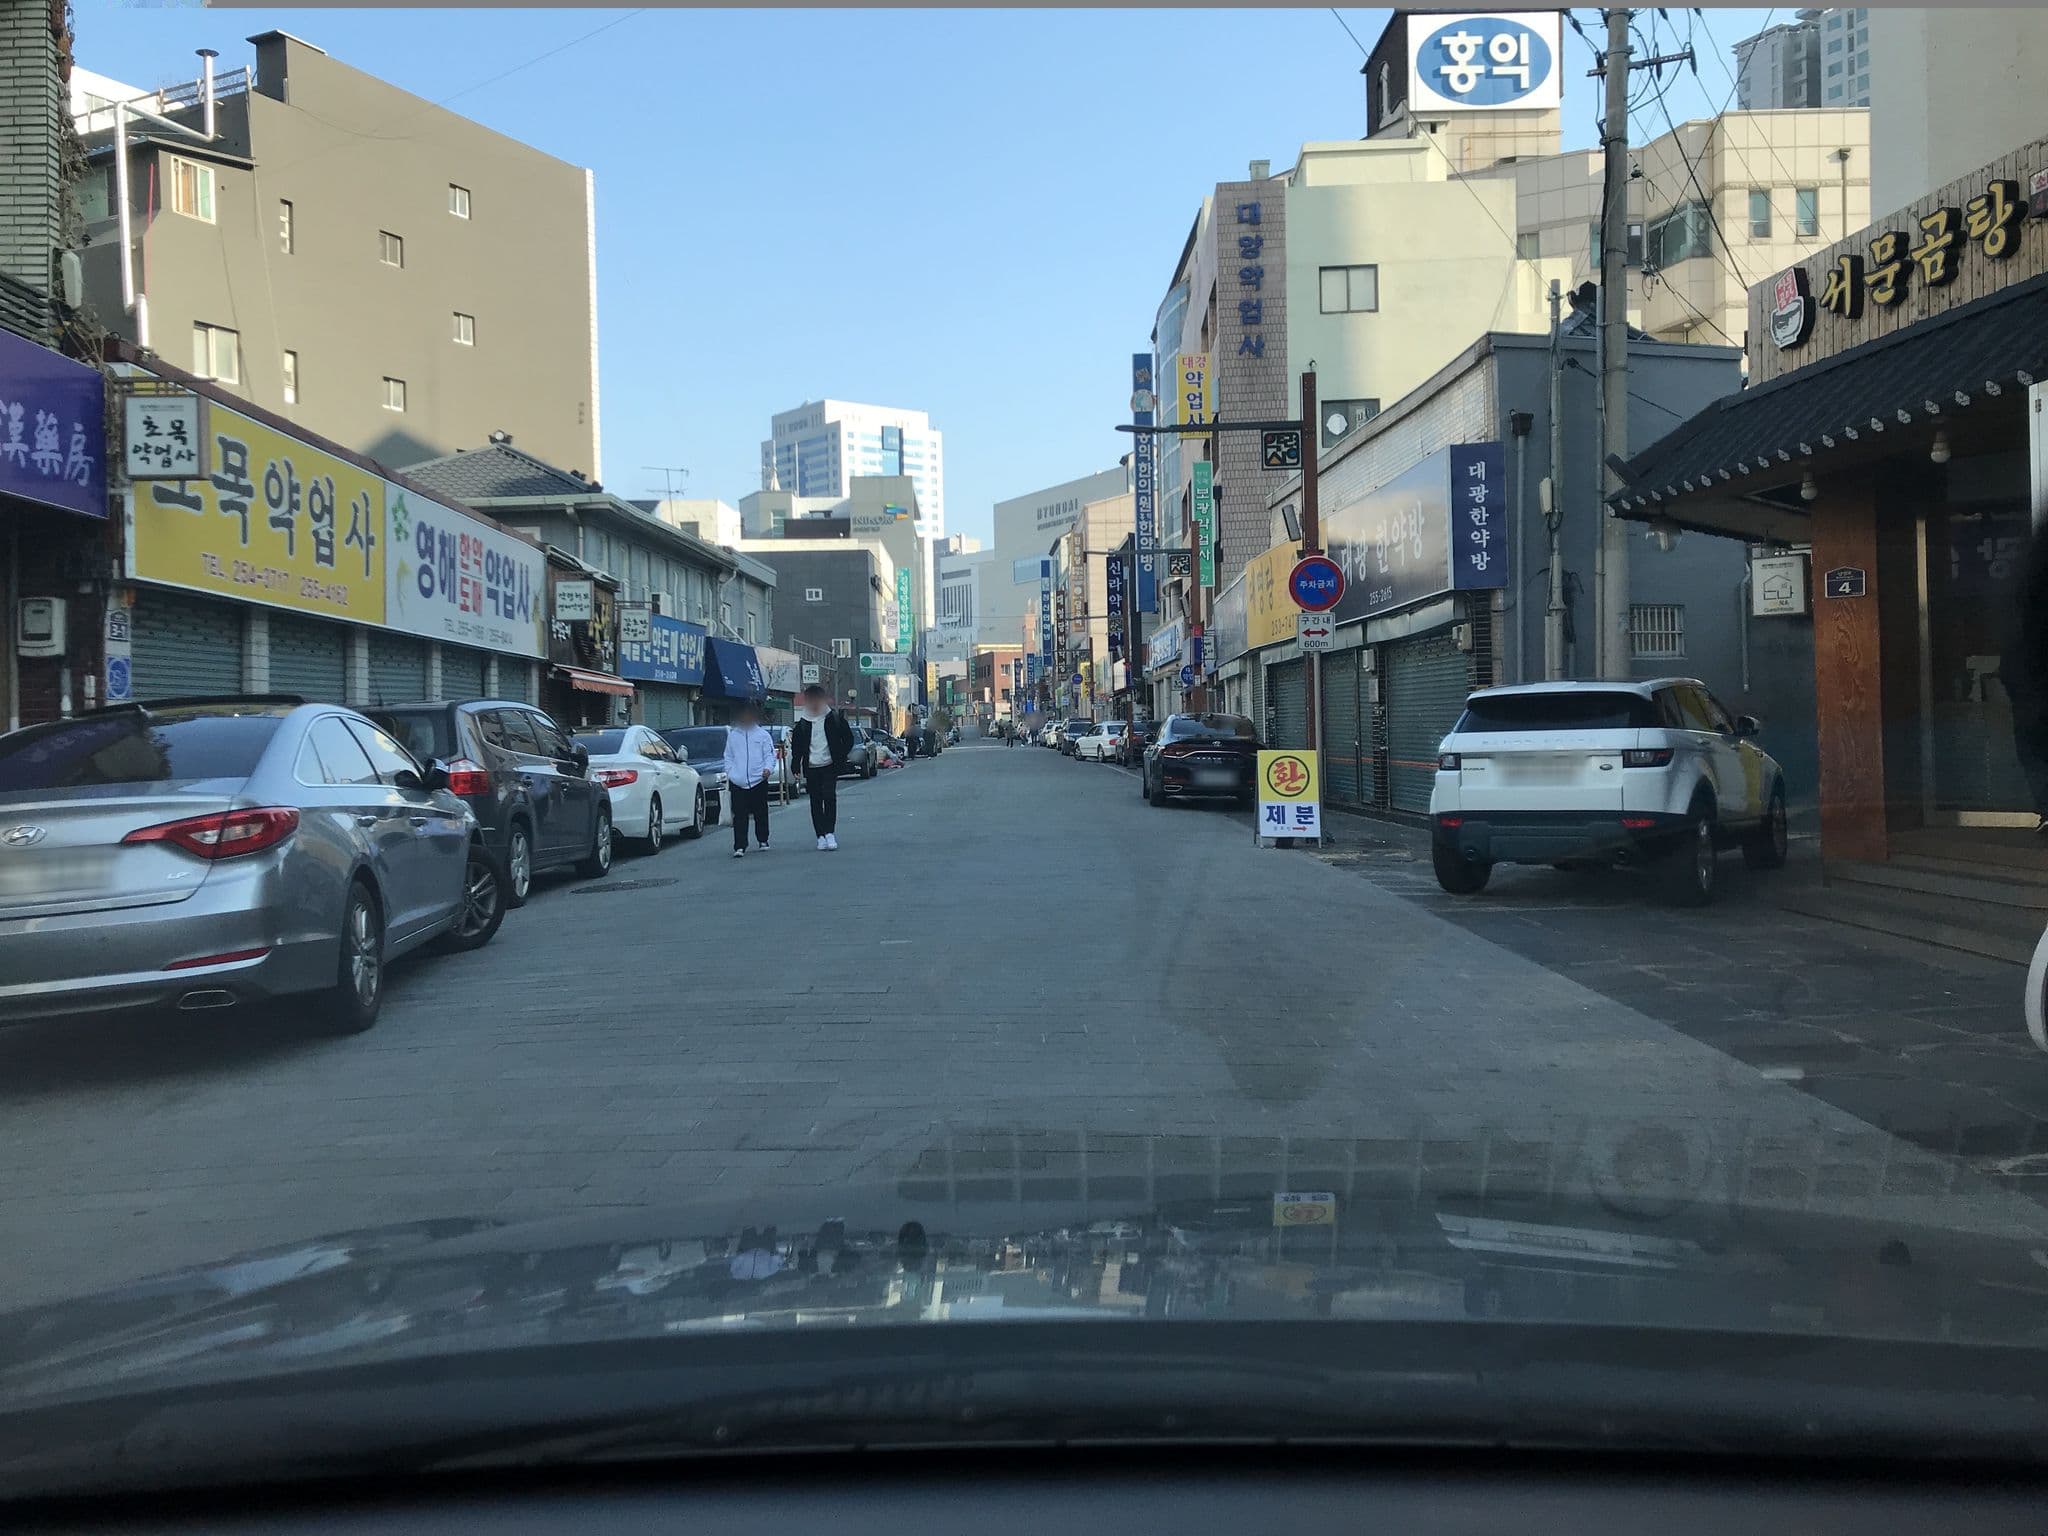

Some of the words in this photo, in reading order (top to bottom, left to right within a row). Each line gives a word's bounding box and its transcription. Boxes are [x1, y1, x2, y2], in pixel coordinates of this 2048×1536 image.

[1441, 31, 1529, 93] 홍익
[1820, 181, 2015, 320] 서문곰탕
[1185, 371, 1205, 429] 약업사
[143, 415, 188, 446] 초목
[132, 442, 197, 468] 약업사
[1468, 460, 1491, 571] 대광한약방
[416, 520, 456, 604] 영해
[485, 548, 530, 624] 약업사
[1300, 579, 1335, 589] 주차금지
[1838, 582, 1852, 594] 4
[1304, 640, 1329, 648] 600m
[1274, 761, 1306, 792] 환
